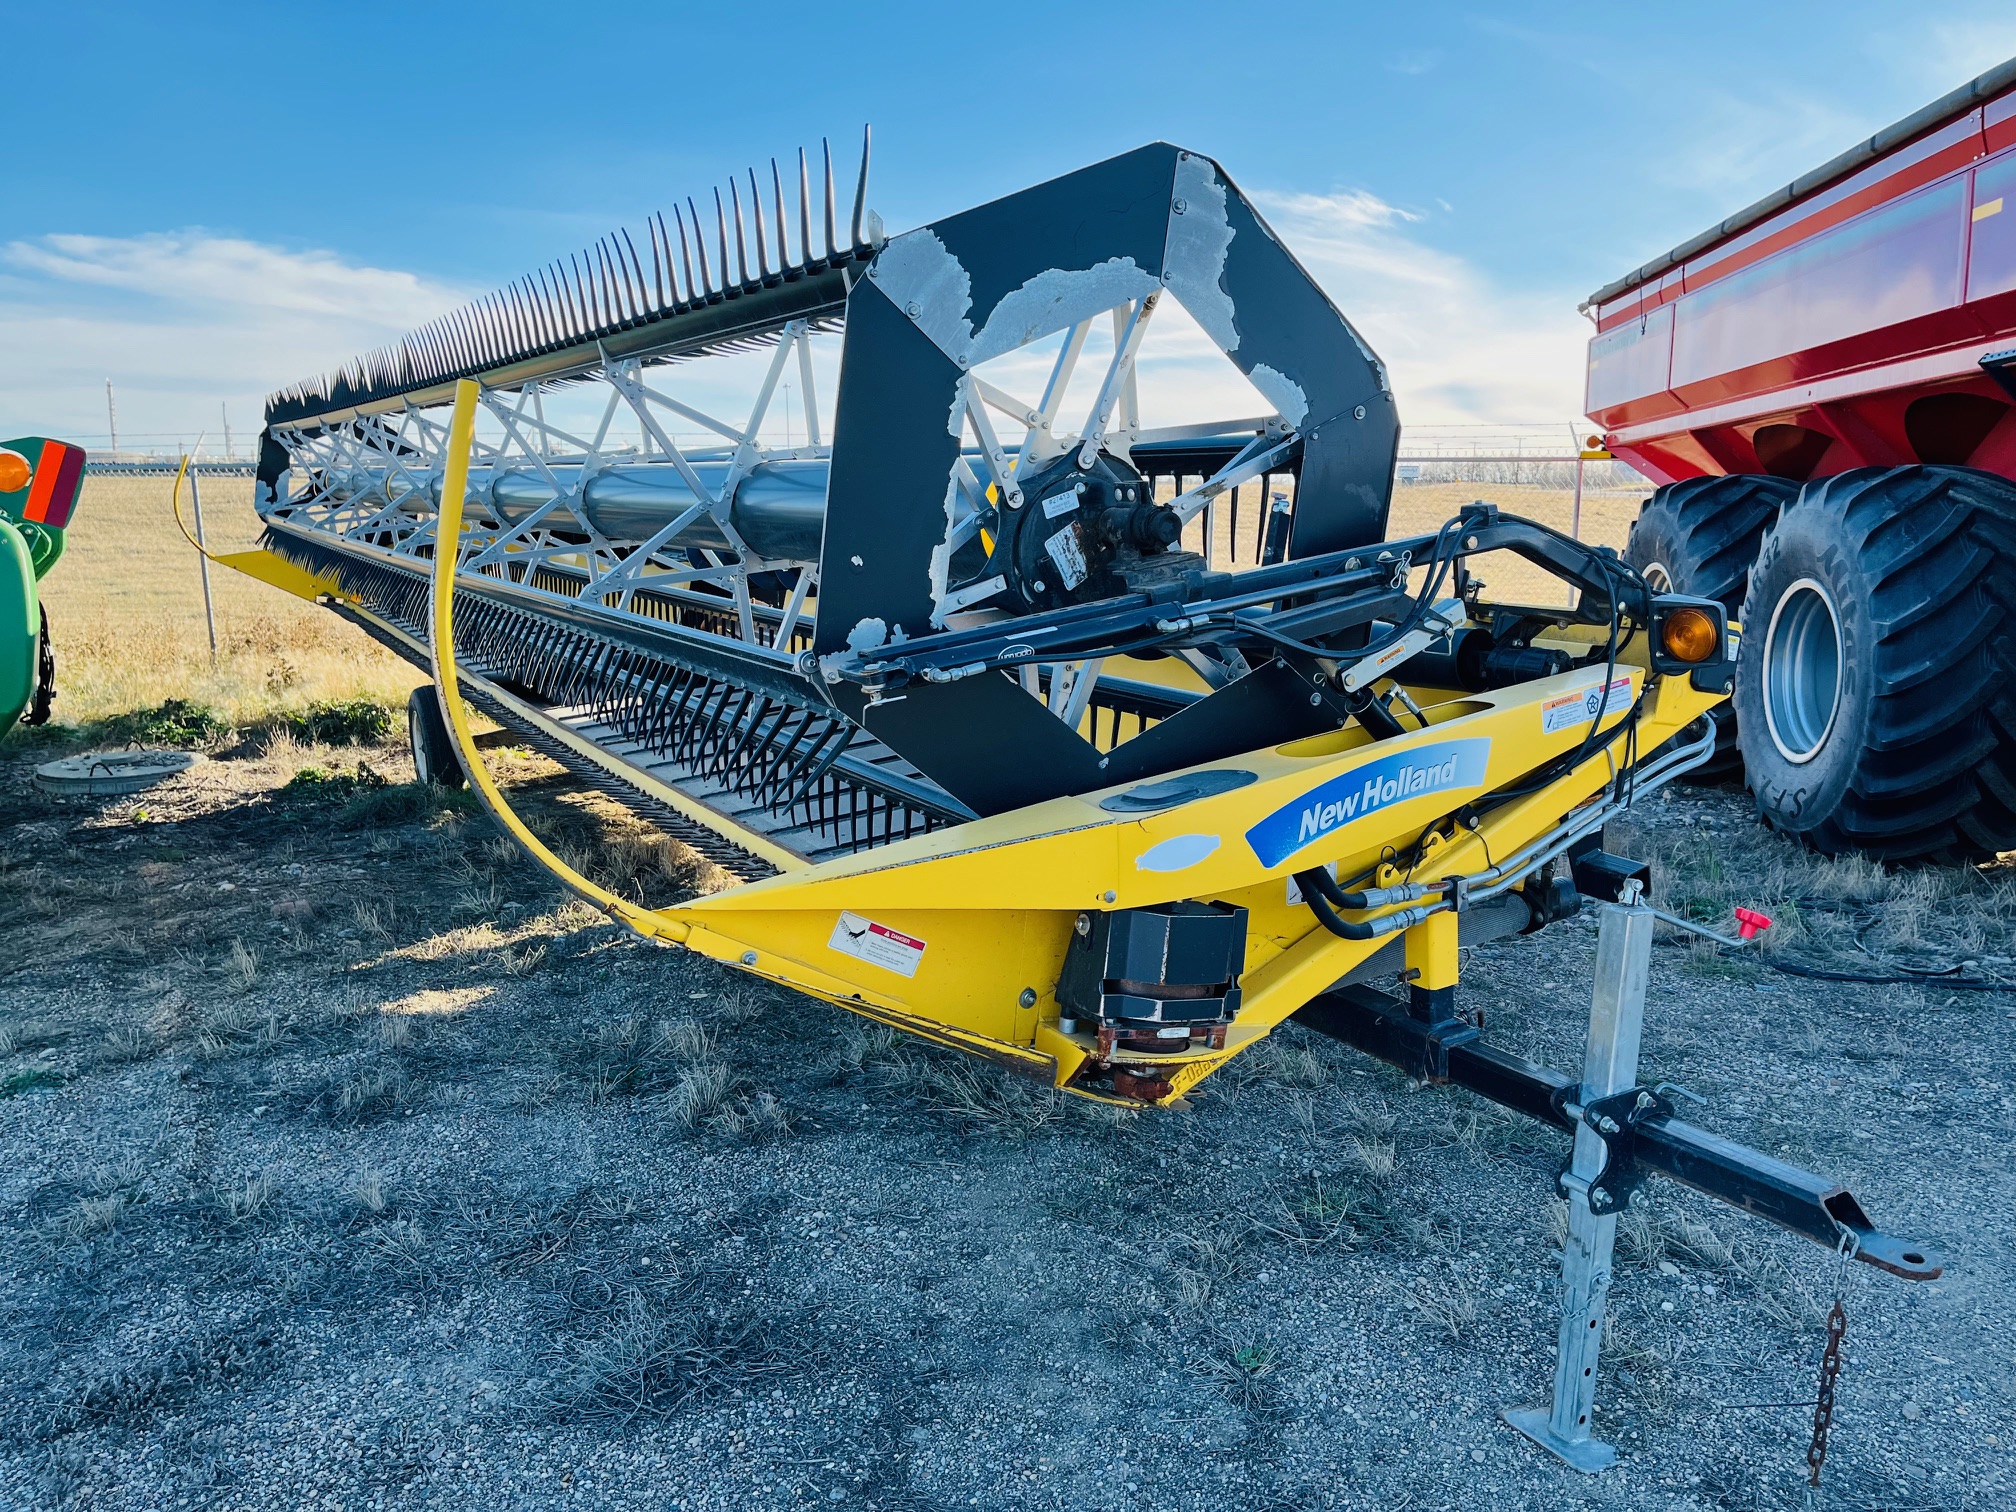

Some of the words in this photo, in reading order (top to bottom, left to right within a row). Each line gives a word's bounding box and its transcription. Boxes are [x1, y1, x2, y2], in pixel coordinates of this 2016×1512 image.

[1763, 535, 1781, 570] 32
[1298, 791, 1359, 843] New
[1361, 753, 1458, 812] Holland
[890, 933, 911, 944] DANGER
